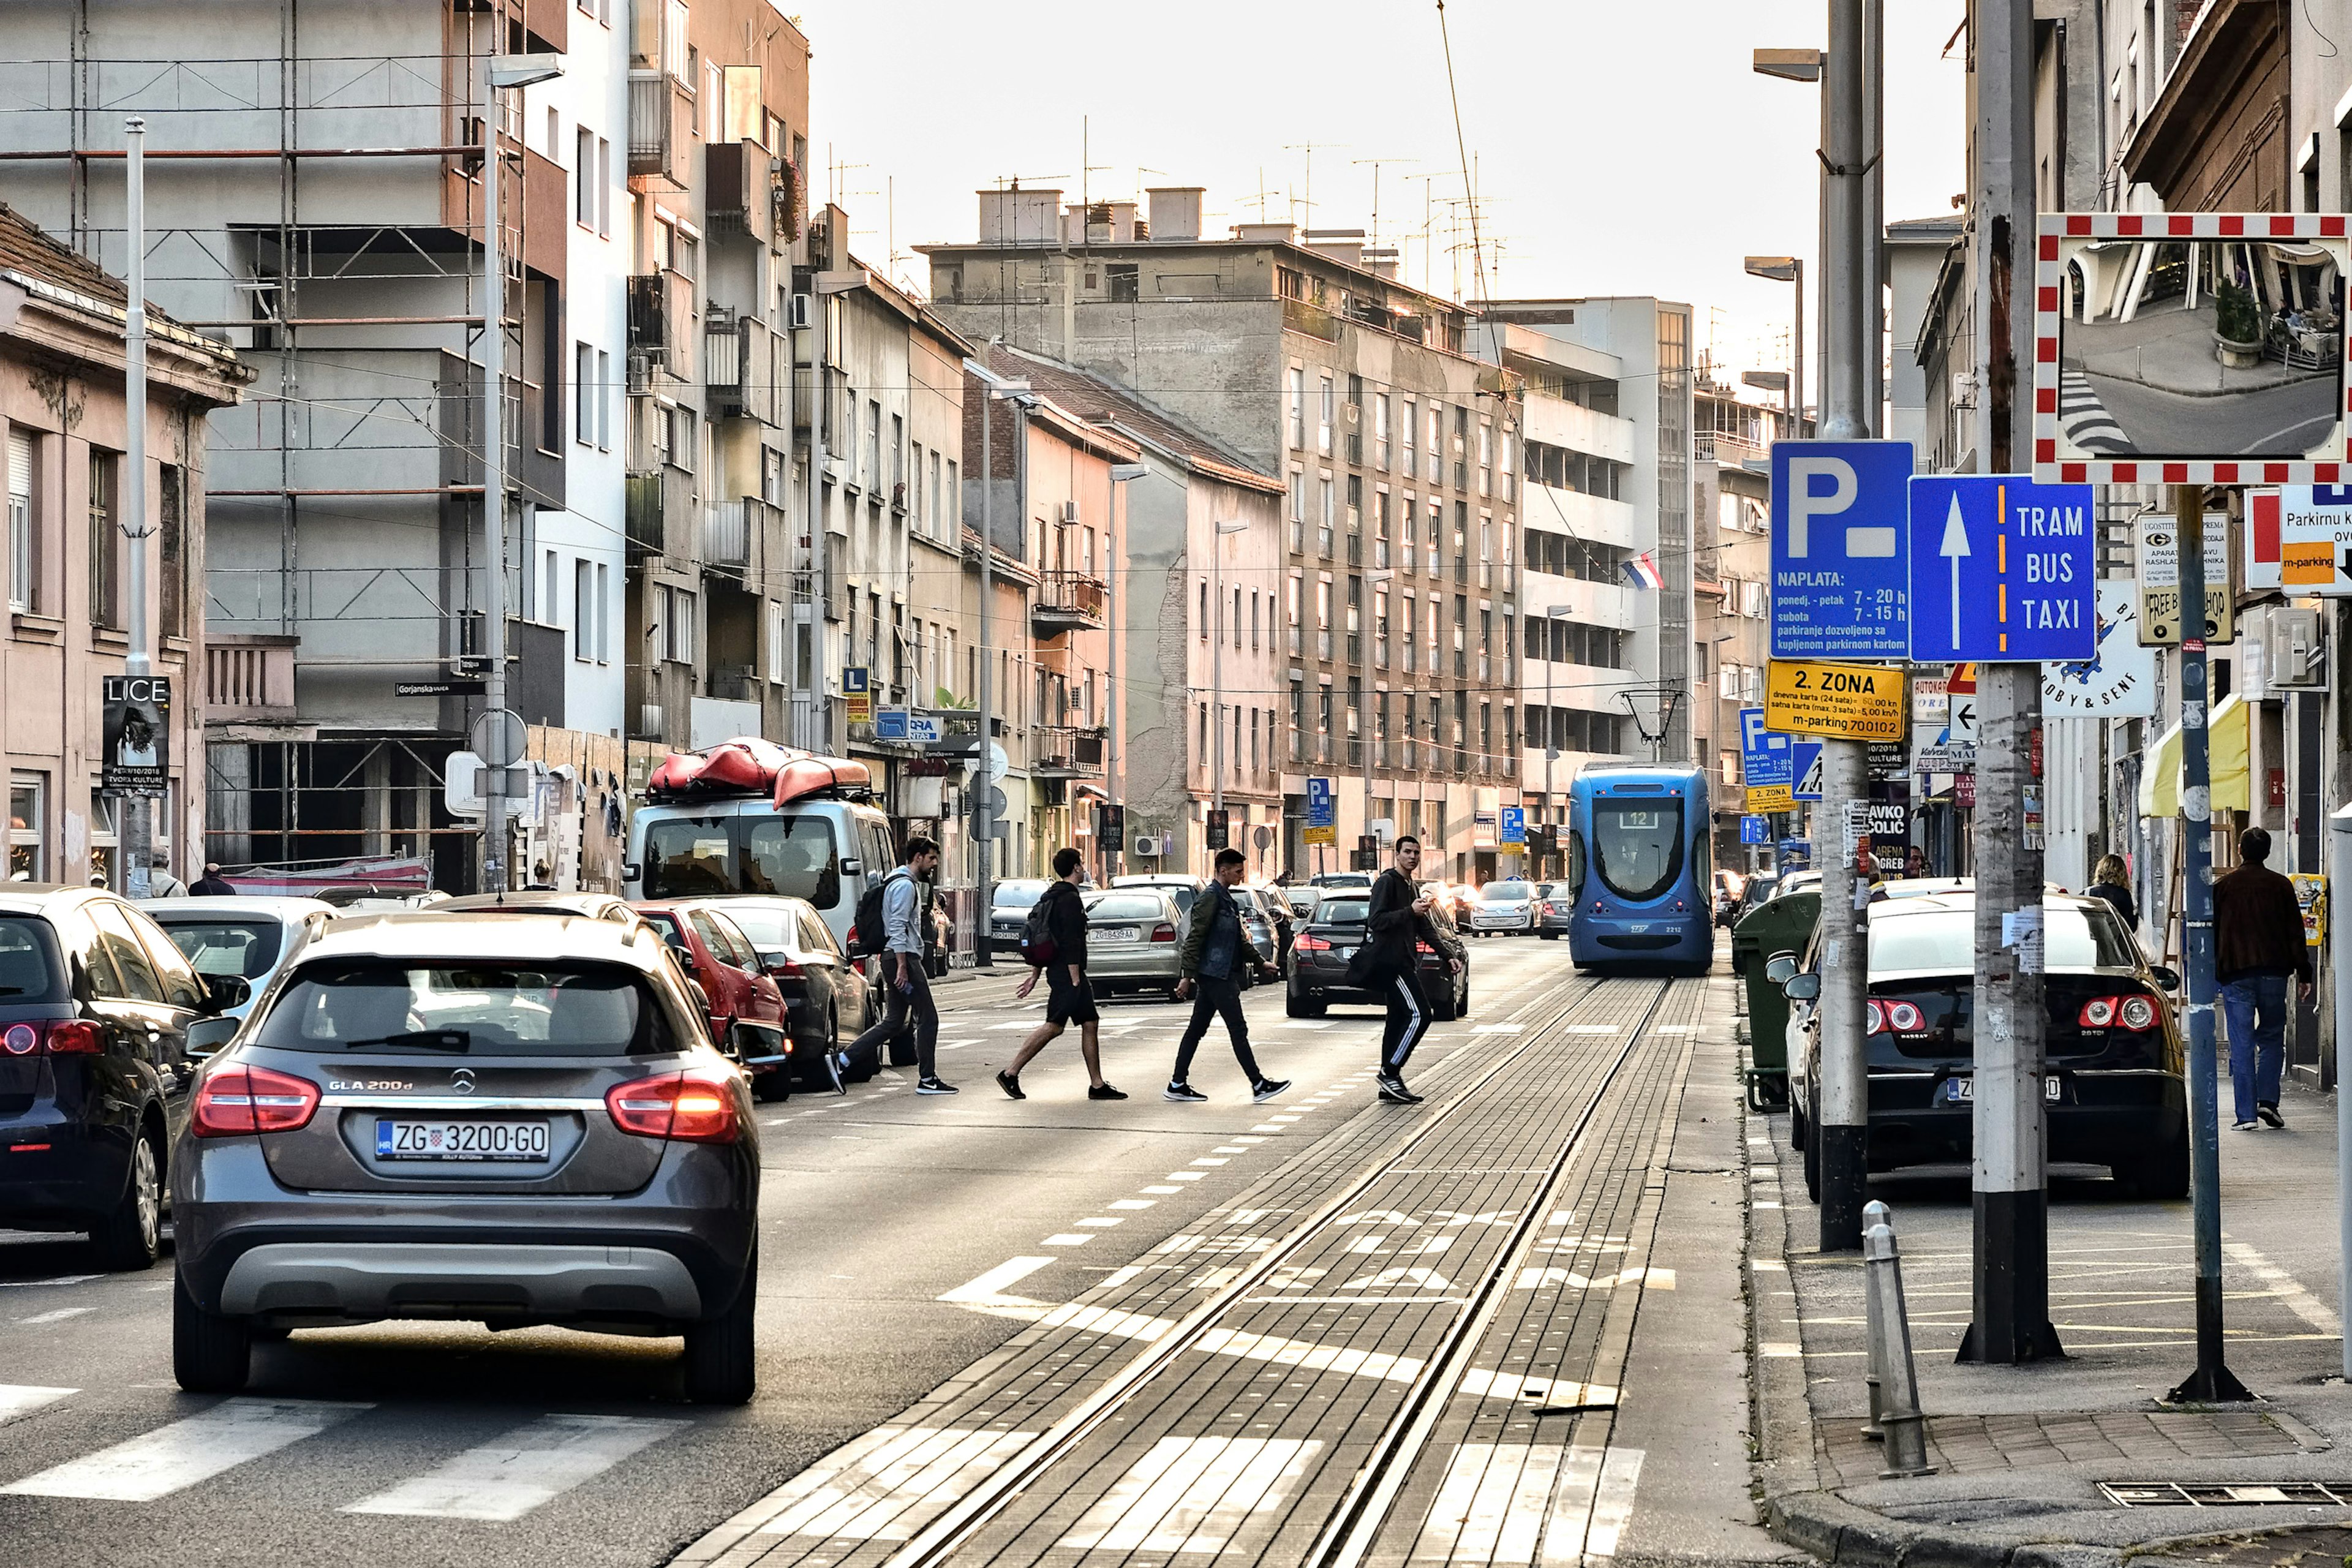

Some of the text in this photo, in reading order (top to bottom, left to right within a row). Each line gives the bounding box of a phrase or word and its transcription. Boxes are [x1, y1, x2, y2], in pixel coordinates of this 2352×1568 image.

[1788, 457, 1857, 558] P
[2016, 506, 2083, 537] TRAM
[2287, 512, 2340, 526] Parkirnu
[2026, 552, 2073, 583] BUS
[2283, 557, 2334, 569] m-parking
[1777, 571, 1845, 586] NAPLATA:
[1777, 595, 1811, 607] ponedj.
[1819, 595, 1844, 607] petak
[1854, 590, 1863, 605] 7
[1876, 589, 1893, 603] 20
[1897, 590, 1906, 605] h
[1777, 611, 1809, 622] subota
[1854, 608, 1863, 621] 7
[1875, 606, 1892, 620] 15
[1897, 608, 1905, 621] h
[2022, 599, 2079, 629] TAXI
[2116, 603, 2136, 622] BY
[2149, 594, 2169, 625] FREE
[2205, 592, 2224, 622] HOP
[1777, 625, 1823, 637] parkiranje
[1825, 625, 1872, 637] dozvoljeno
[1777, 639, 1905, 652] kupljenom parkirnom kartom
[108, 679, 167, 702] LICE
[399, 685, 433, 694] Gorjanska
[1795, 671, 1875, 695] 2. ZONA
[2085, 698, 2094, 708] &
[2101, 673, 2136, 705] SENF
[1773, 691, 1798, 699] dnevna
[1800, 693, 1818, 701] karta
[1812, 704, 1831, 712] (max.
[1793, 715, 1896, 733] m-parking 700102
[1630, 812, 1646, 825] 12
[1869, 805, 1904, 819] AVKO
[1875, 846, 1904, 857] ARENA
[1880, 858, 1904, 869] GREB
[329, 1081, 364, 1090] GLA
[379, 1141, 391, 1150] HR
[396, 1126, 426, 1150] ZG
